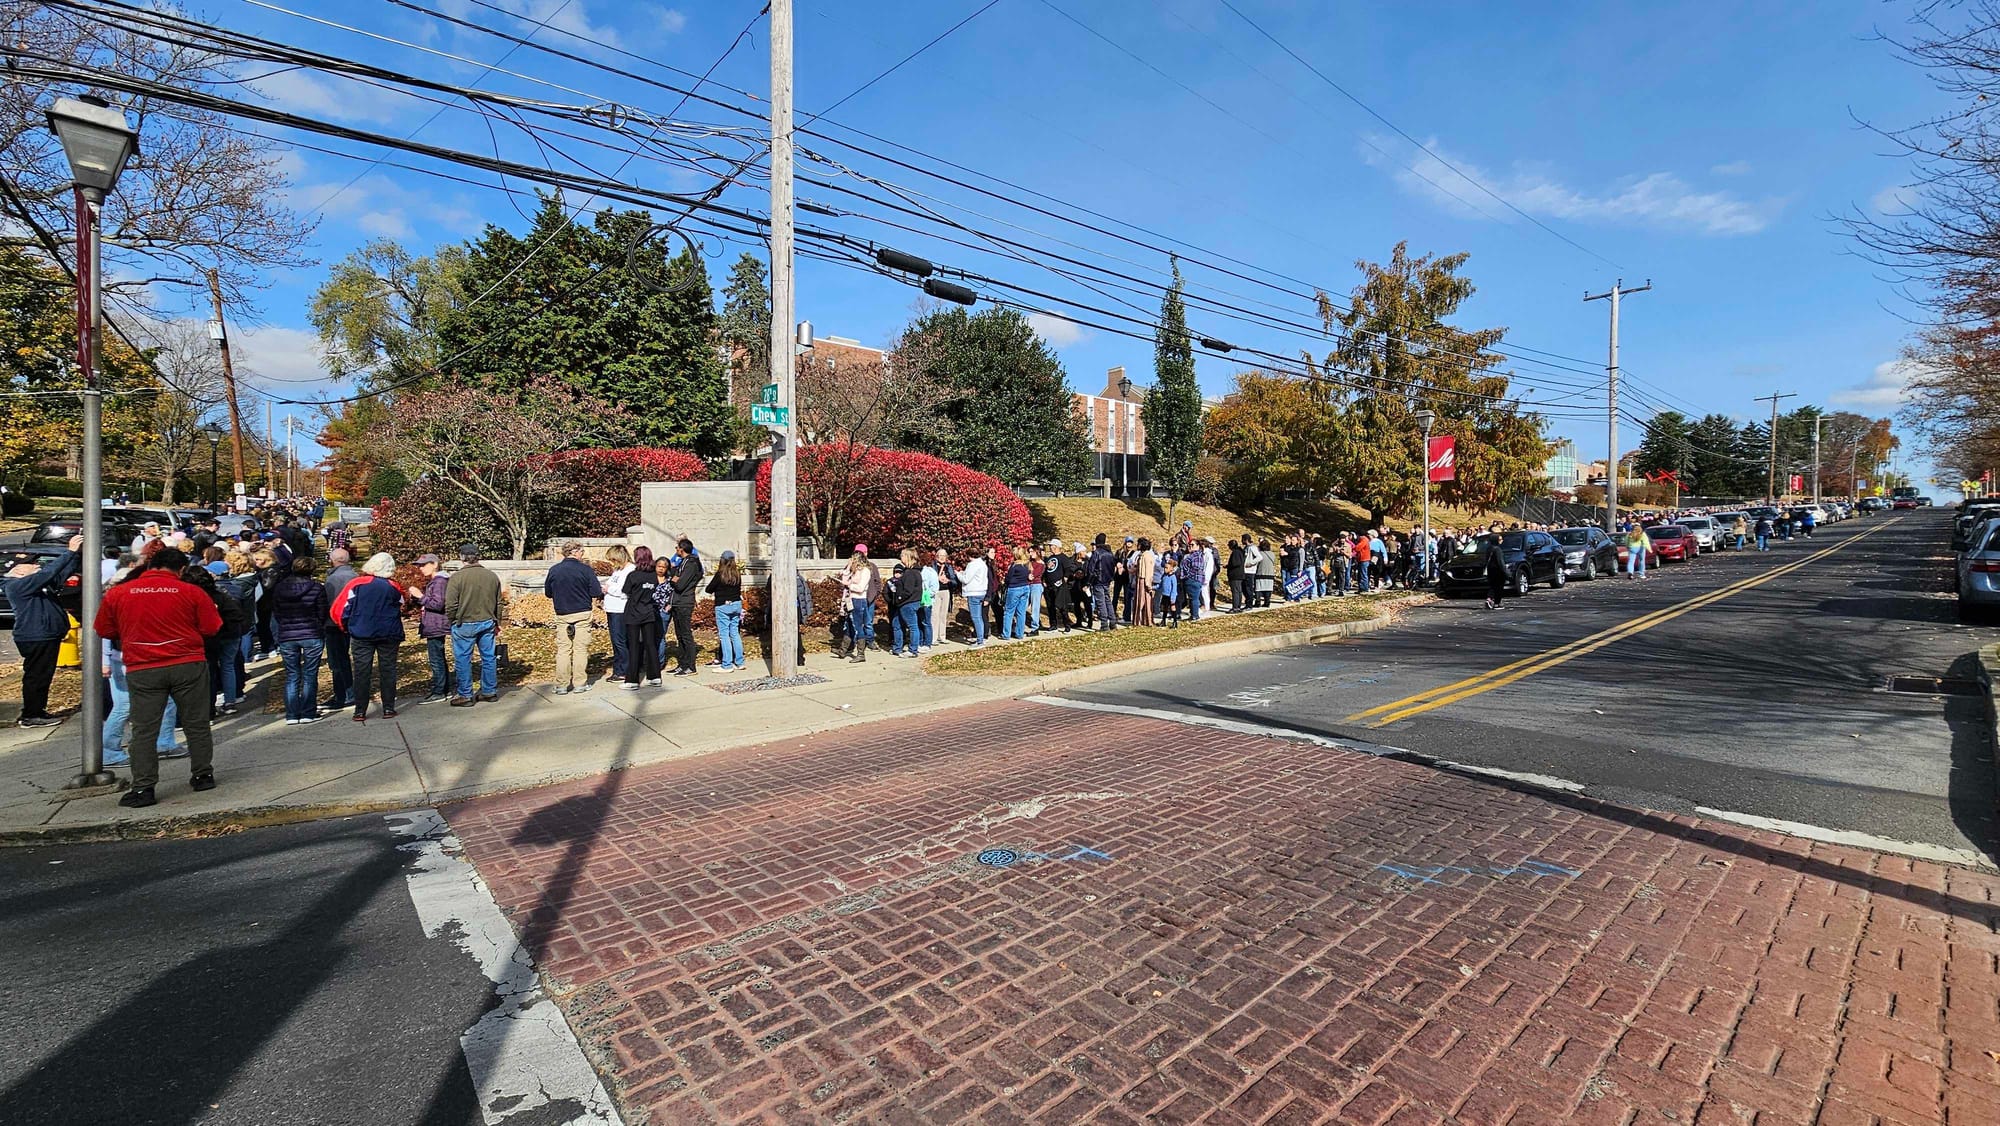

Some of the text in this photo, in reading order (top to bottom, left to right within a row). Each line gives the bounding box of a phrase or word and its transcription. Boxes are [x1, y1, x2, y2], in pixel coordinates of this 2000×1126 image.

[752, 406, 788, 423] Chew St
[649, 503, 743, 515] MUHLENBERG
[666, 518, 726, 530] COLLEGE
